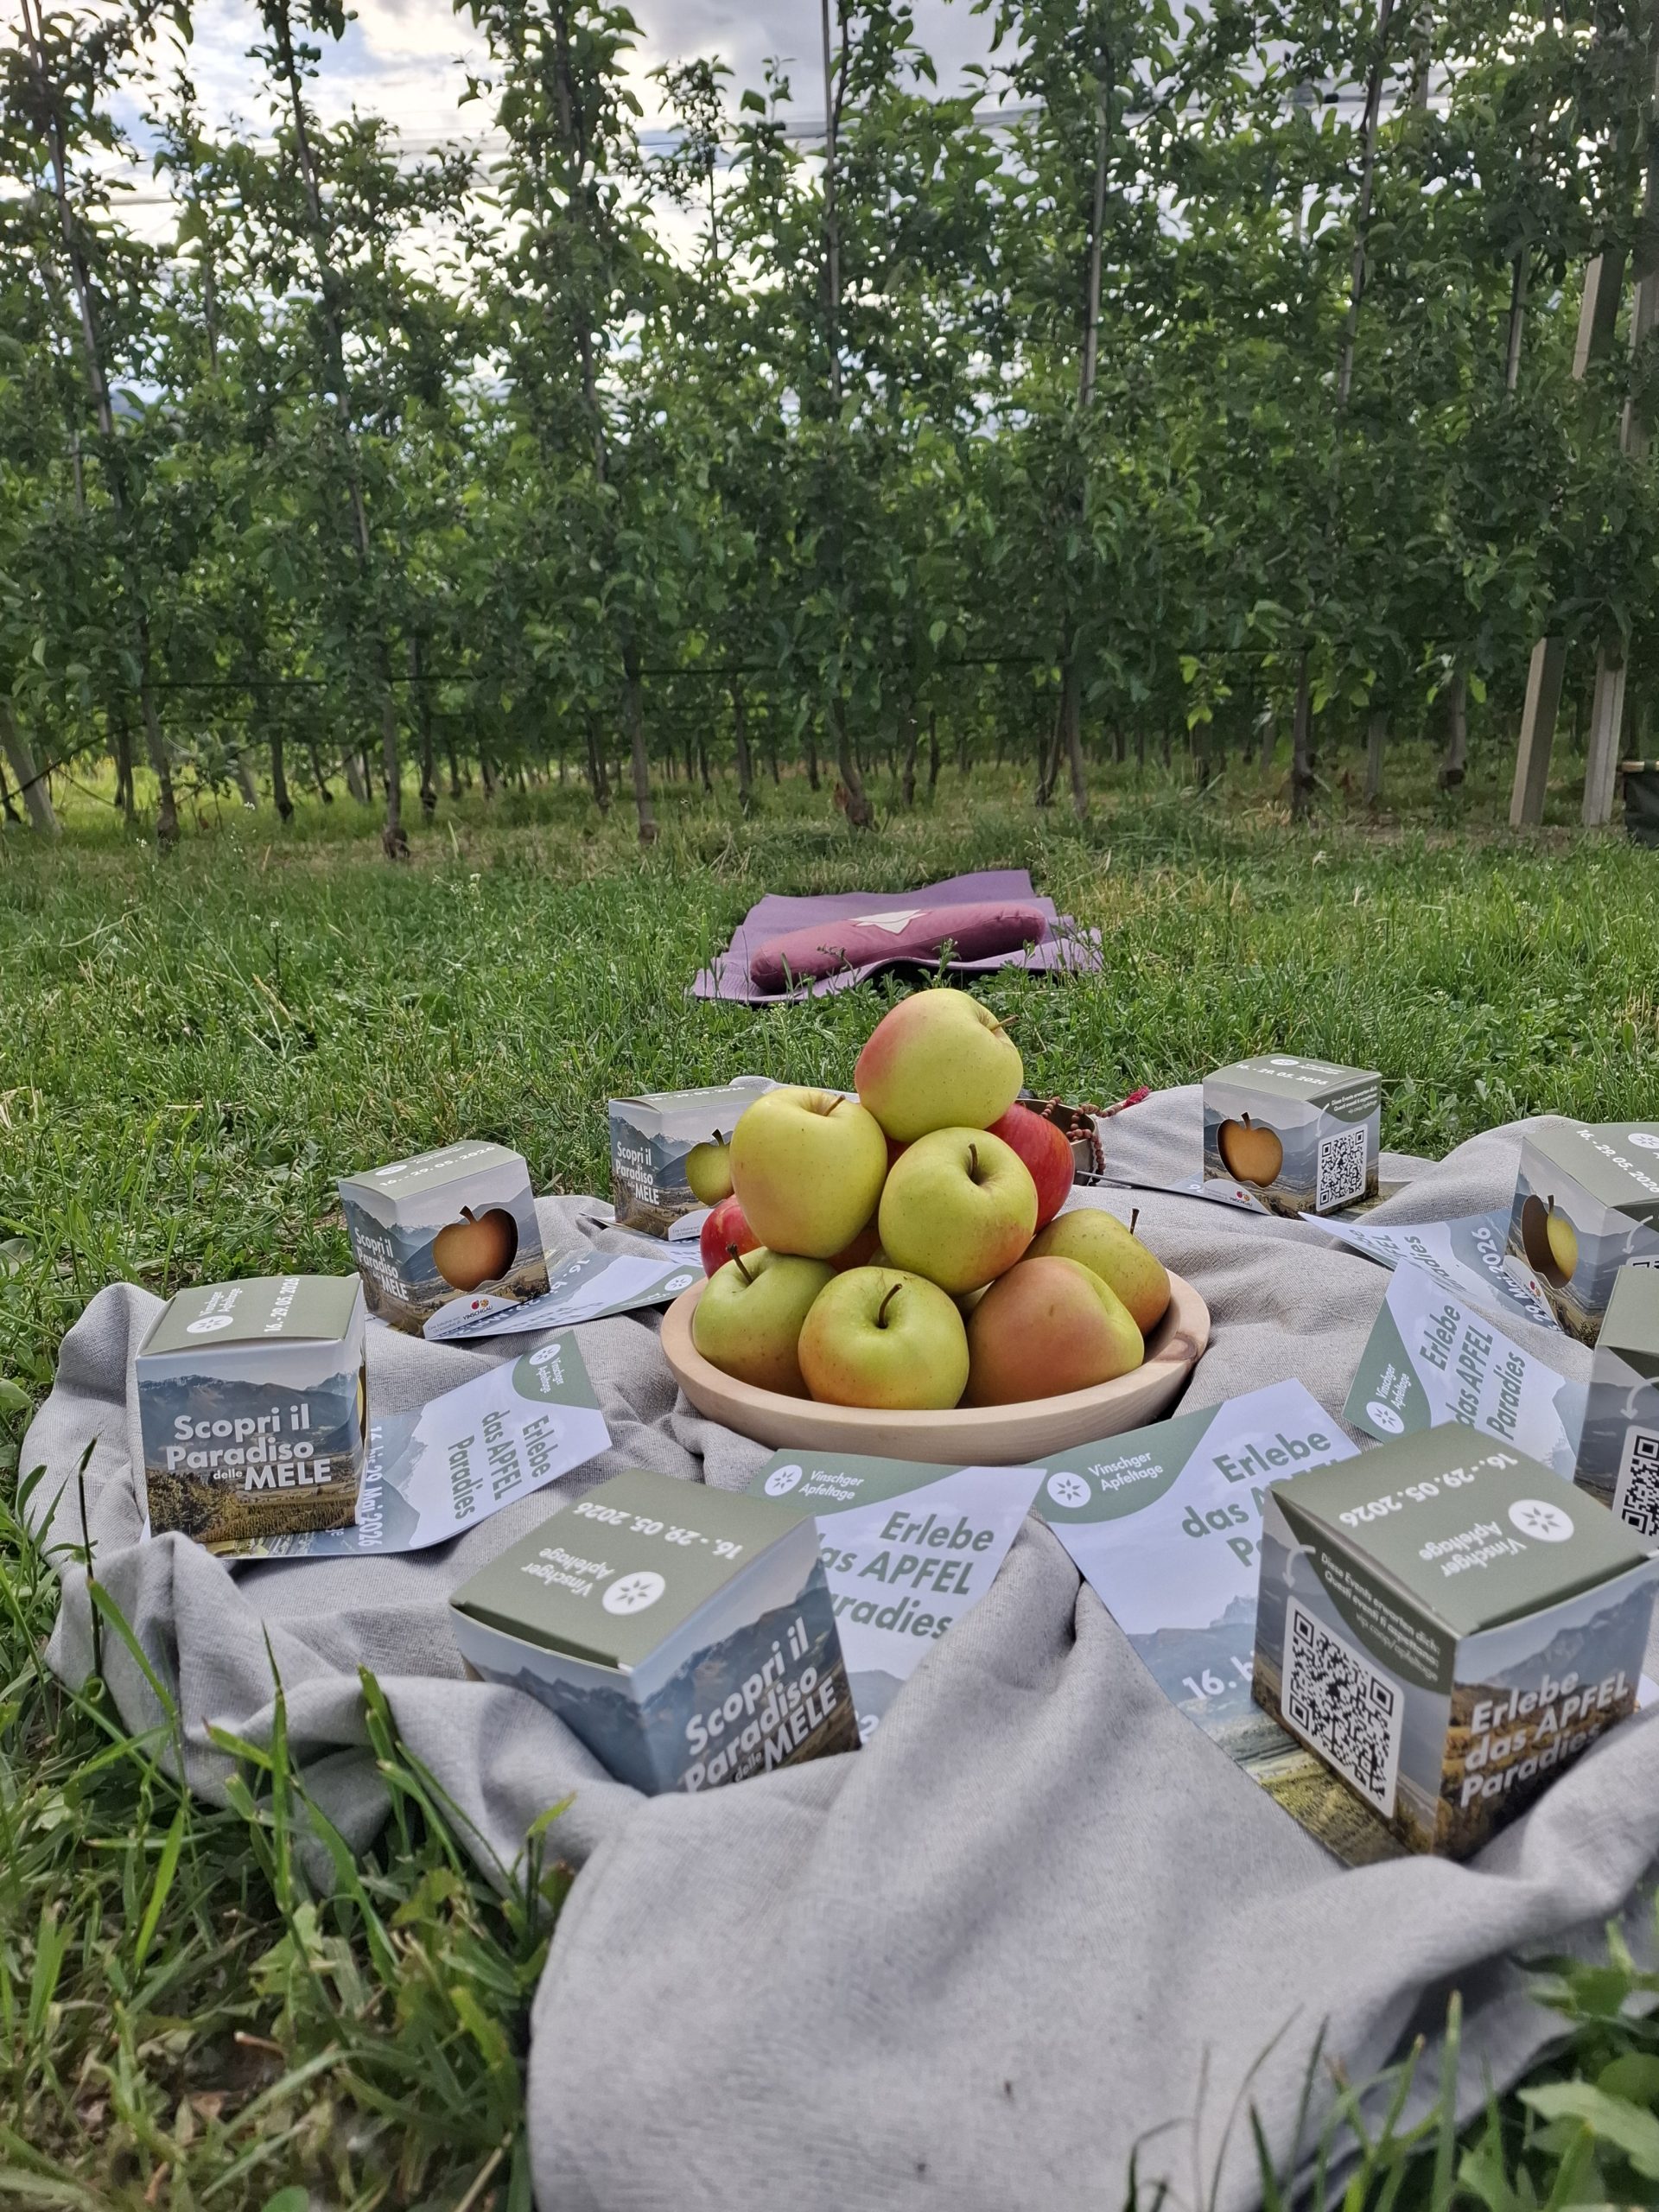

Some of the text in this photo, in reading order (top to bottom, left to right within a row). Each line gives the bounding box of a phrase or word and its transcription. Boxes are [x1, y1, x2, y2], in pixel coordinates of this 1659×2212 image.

[616, 1159, 653, 1185] Paradiso
[617, 1141, 652, 1166] Scopri il
[635, 1183, 659, 1205] MELE
[354, 1227, 393, 1258] Scopri il
[1471, 1227, 1503, 1274] 2026
[356, 1246, 398, 1279] Paradiso
[279, 1277, 300, 1295] 2026
[380, 1274, 409, 1301] MELE
[1419, 1305, 1461, 1371] Erlebe
[1376, 1363, 1396, 1400] Vinschger
[1390, 1372, 1412, 1411] Apfeltage
[1445, 1325, 1494, 1425] das APFEL
[1485, 1351, 1526, 1441] Paradies
[174, 1403, 310, 1443] Scopri il
[166, 1437, 315, 1471] Paradiso
[481, 1409, 524, 1500] das APFEL
[522, 1414, 559, 1478] Erlebe
[1088, 1451, 1153, 1478] Vinschger
[1212, 1432, 1332, 1484] Erlebe
[213, 1458, 332, 1491] delle MELE
[447, 1434, 484, 1520] Paradies
[798, 1483, 856, 1501] Apfeltage
[810, 1471, 865, 1487] Vinschger
[1100, 1465, 1165, 1492] Apfeltage
[361, 1486, 384, 1513] Mai
[572, 1502, 632, 1526] 2026
[1338, 1495, 1403, 1529] 2026
[358, 1512, 383, 1547] 2026
[879, 1511, 994, 1552] Erlebe
[1181, 1503, 1250, 1538] das
[1418, 1521, 1503, 1560] Apfeltage
[1440, 1537, 1528, 1578] Vinschger
[520, 1561, 594, 1597] Vinschger
[538, 1548, 615, 1580] Apfeltage
[818, 1533, 974, 1595] as APFEL
[1321, 1552, 1344, 1579] Diese
[1344, 1571, 1373, 1602] Events
[1373, 1598, 1414, 1636] erwarten
[1325, 1570, 1352, 1599] Questi
[1352, 1596, 1380, 1622] eventi
[830, 1593, 953, 1640] radies
[685, 1640, 785, 1756] Scopri
[787, 1616, 809, 1662] il
[1182, 1669, 1237, 1700] 16.
[1471, 1671, 1580, 1735] Erlebe
[684, 1666, 817, 1792] Paradiso
[734, 1751, 762, 1783] delle
[764, 1675, 837, 1772] MELE
[1465, 1670, 1629, 1771] das APFEL
[1460, 1723, 1601, 1808] Paradies
